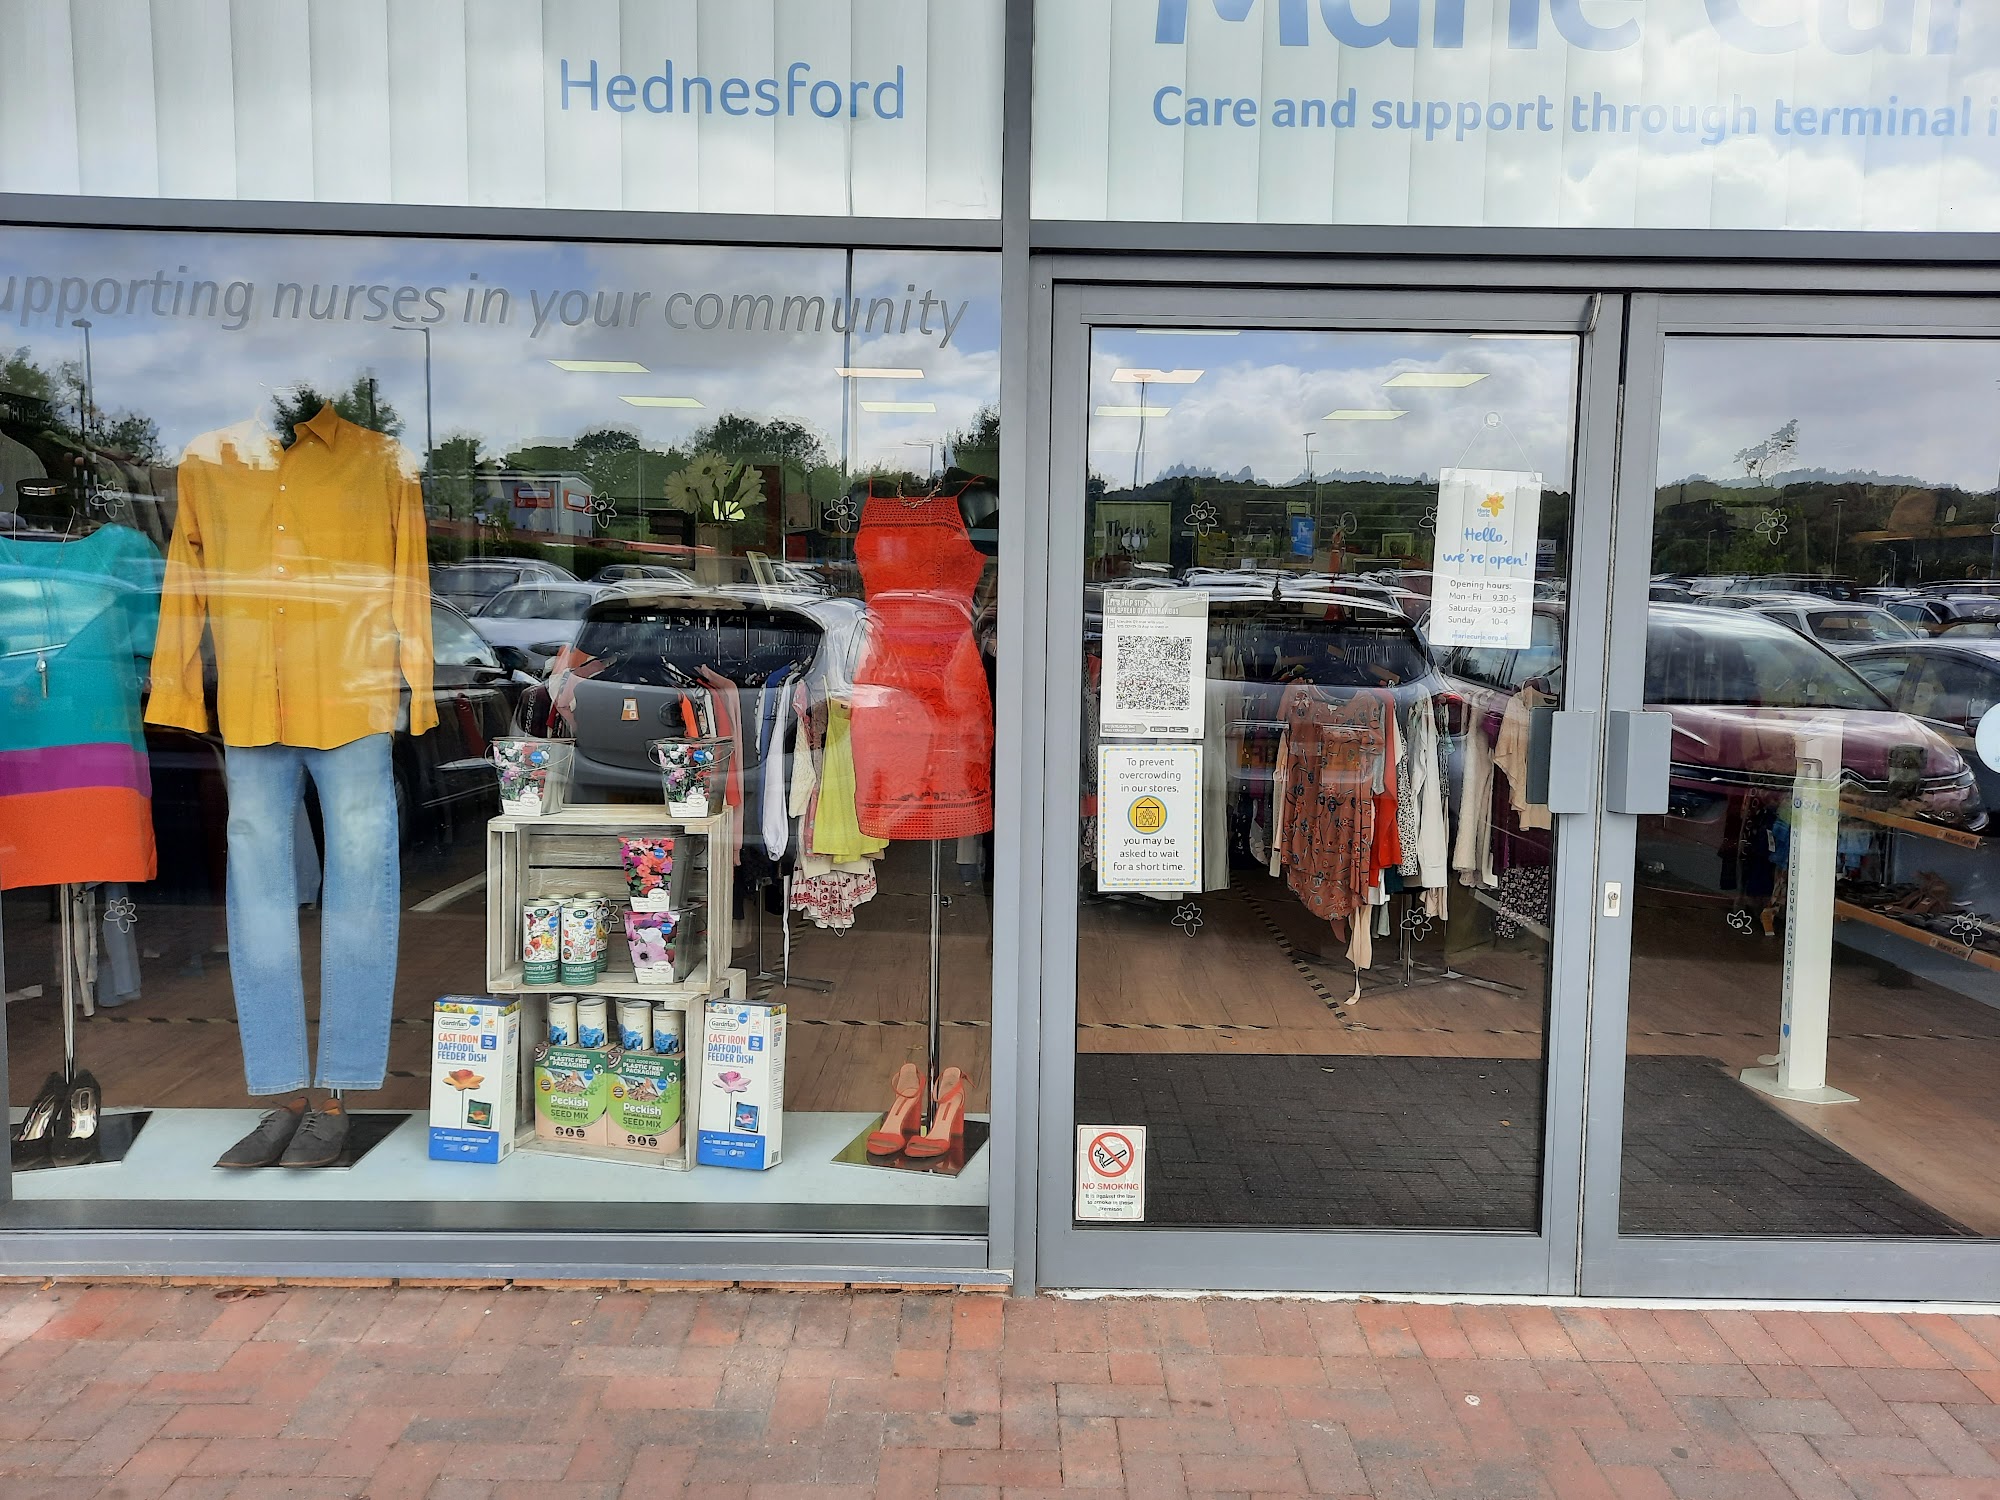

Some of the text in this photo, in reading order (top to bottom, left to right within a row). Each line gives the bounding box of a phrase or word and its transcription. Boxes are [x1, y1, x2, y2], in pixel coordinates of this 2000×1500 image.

[561, 59, 905, 120] Hednesford
[1152, 86, 1258, 129] Care
[1271, 88, 1357, 130] and
[1372, 95, 1553, 143] support
[1569, 91, 1758, 146] through
[1774, 95, 1971, 138] terminal
[273, 278, 447, 324] nurses
[463, 272, 507, 324] in
[529, 288, 651, 338] your
[666, 283, 969, 349] community
[1464, 527, 1508, 545] Hello,
[1443, 547, 1528, 570] we're open!
[1450, 579, 1512, 590] Opening hours:
[1449, 592, 1466, 600] Mon
[1472, 593, 1482, 601] Fri
[1492, 594, 1516, 602] 9.30-5
[1448, 604, 1516, 614] Saturday 9.30-5
[1447, 616, 1508, 625] Sunday 10-4
[1126, 757, 1174, 768] To prevent
[1119, 771, 1181, 781] overcrowding
[1121, 783, 1179, 793] in our stores,
[1123, 836, 1175, 846] you may be
[1119, 849, 1179, 858] asked to wait
[1113, 862, 1186, 871] for a short time.
[438, 1033, 457, 1042] CAST
[459, 1034, 479, 1044] IRON
[708, 1034, 726, 1043] CAST
[728, 1035, 746, 1045] IRON
[437, 1042, 475, 1053] DAFFODIL
[708, 1043, 743, 1054] DAFFODIL
[437, 1051, 487, 1063] FEEDER DISH
[707, 1052, 754, 1064] FEEDER DISH
[552, 1061, 588, 1069] PACKAGING
[623, 1062, 648, 1070] PLASTIC
[625, 1068, 660, 1076] PACKAGING
[550, 1095, 589, 1107] Peckish
[623, 1102, 662, 1115] Peckish
[551, 1109, 589, 1120] SEED MIX
[622, 1117, 662, 1128] SEED MIX
[1082, 1182, 1139, 1190] NO SMOKING
